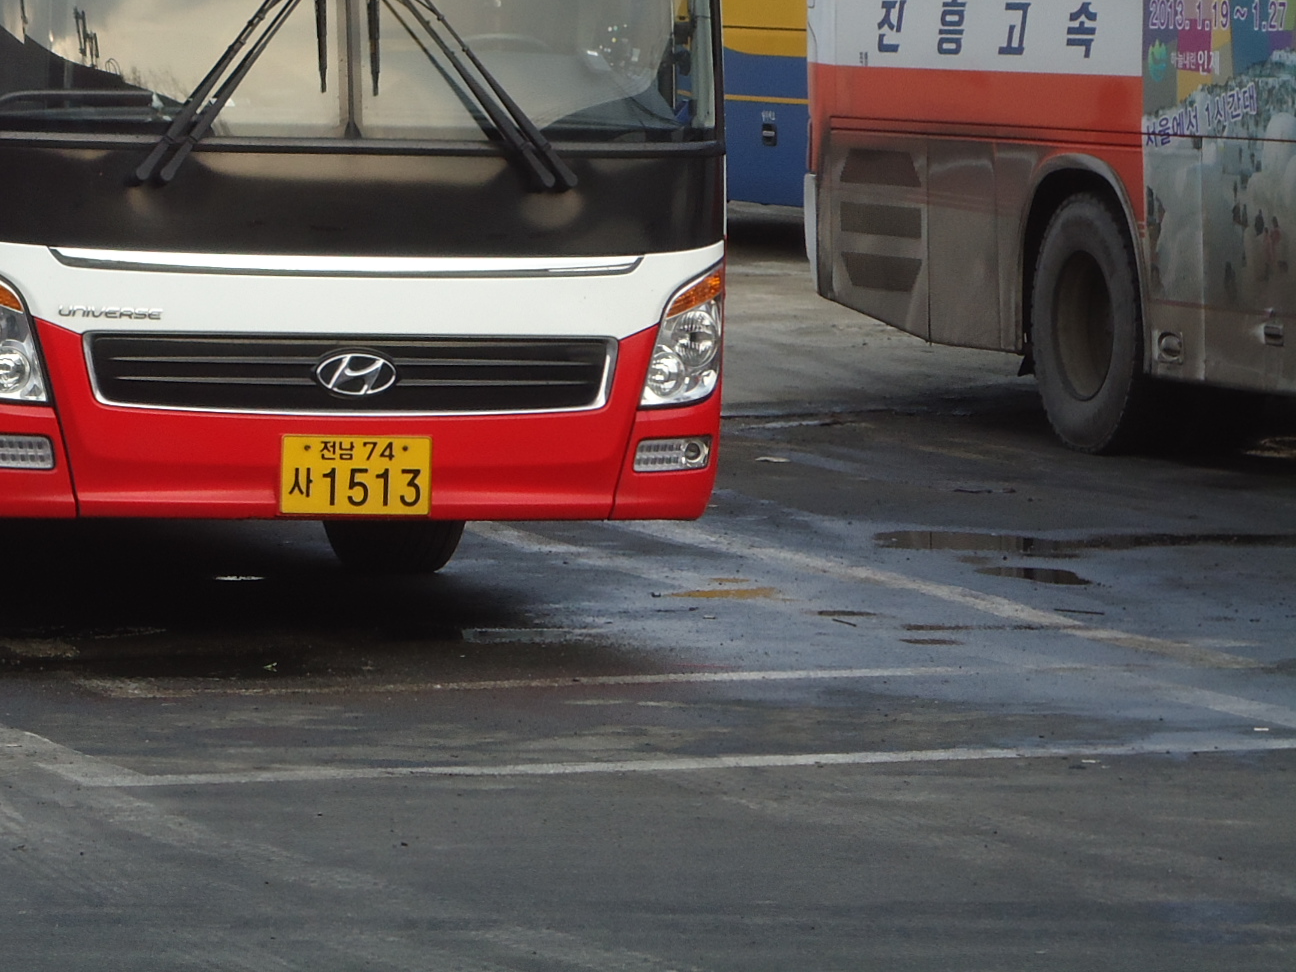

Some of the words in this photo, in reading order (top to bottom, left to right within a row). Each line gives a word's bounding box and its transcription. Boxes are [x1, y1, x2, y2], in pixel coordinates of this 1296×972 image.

[1146, 103, 1199, 148] 서울에서
[58, 305, 163, 320] UNIVERSE
[320, 441, 355, 461] 전남
[362, 441, 395, 461] 74
[288, 467, 314, 498] 사
[322, 467, 421, 507] 1513
